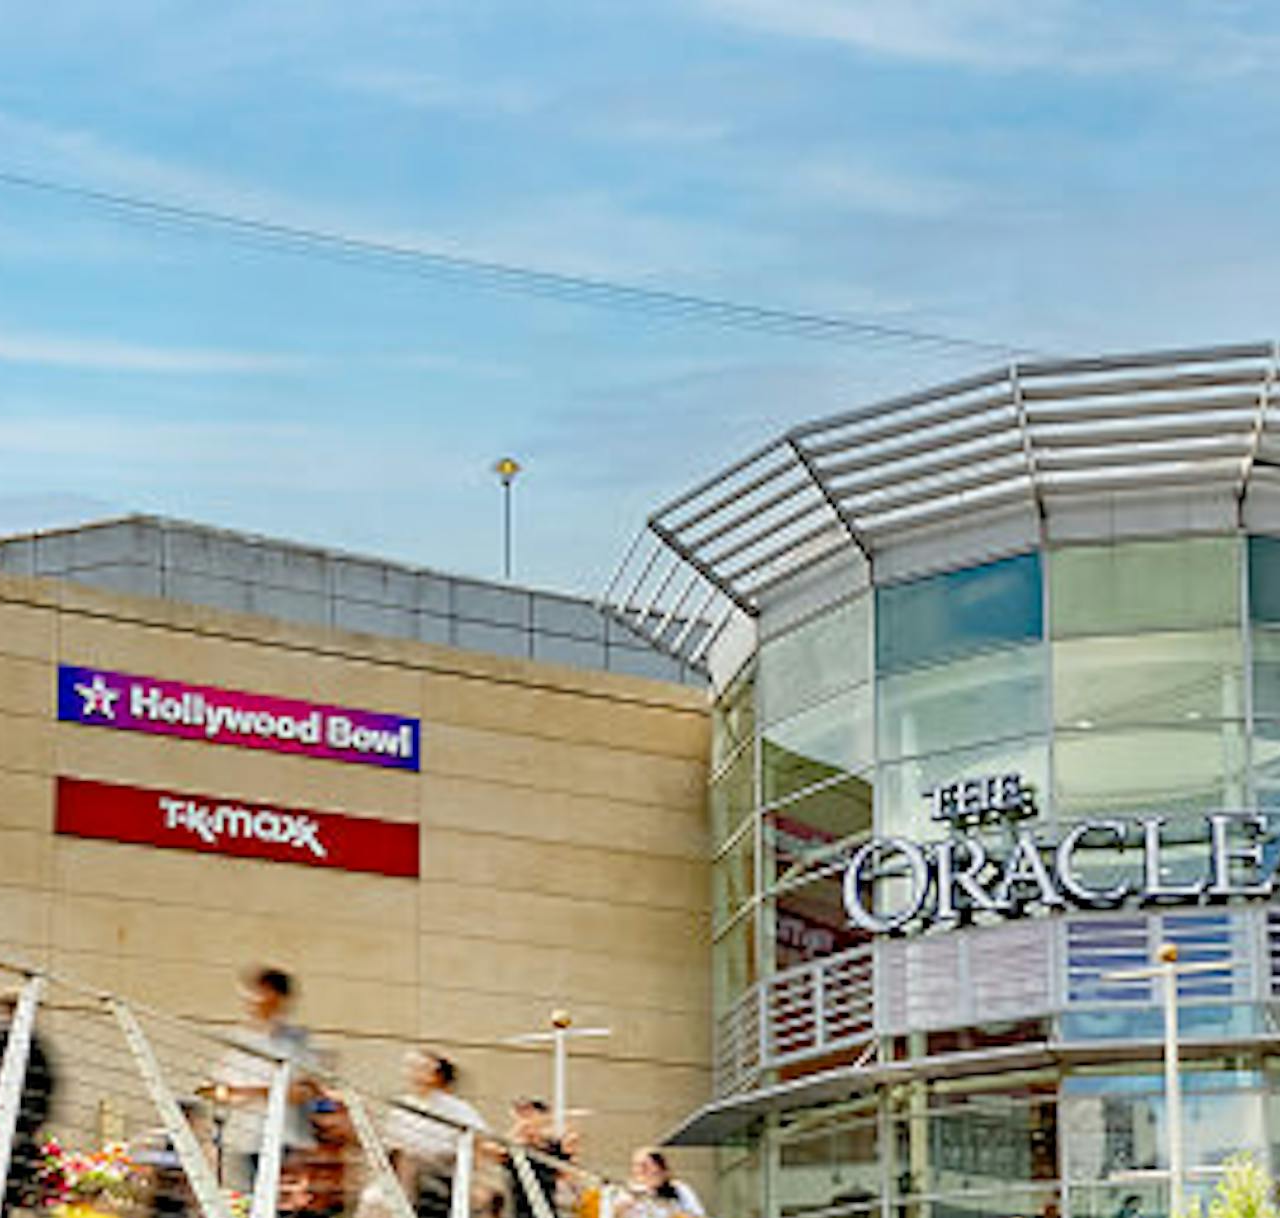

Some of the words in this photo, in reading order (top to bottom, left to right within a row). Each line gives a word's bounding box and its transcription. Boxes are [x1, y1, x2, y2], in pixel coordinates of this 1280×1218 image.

[130, 683, 320, 744] Hollywood
[327, 715, 413, 757] Bowl
[922, 774, 1032, 820] THE
[842, 815, 1278, 932] ORACLE
